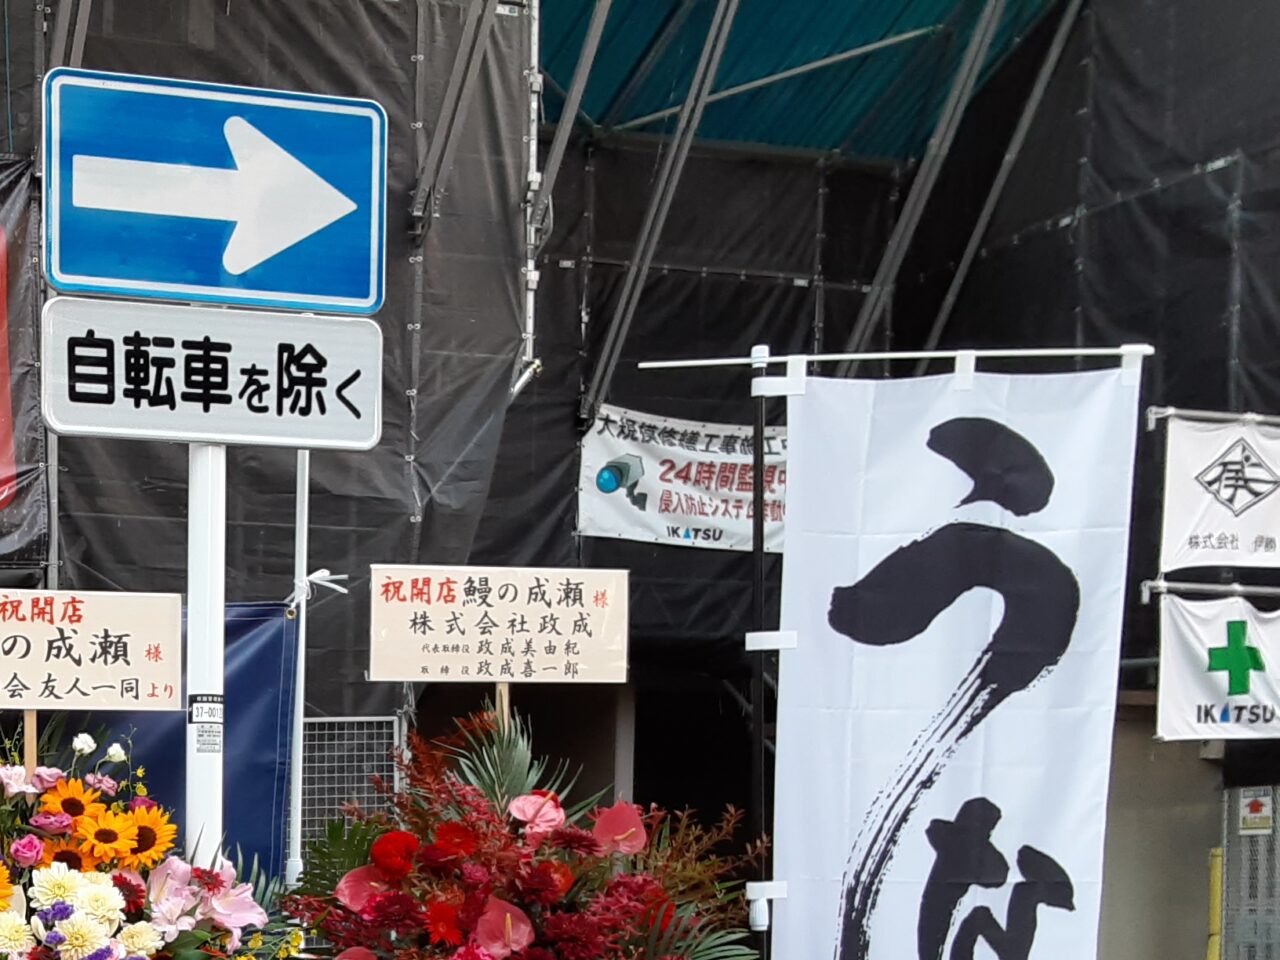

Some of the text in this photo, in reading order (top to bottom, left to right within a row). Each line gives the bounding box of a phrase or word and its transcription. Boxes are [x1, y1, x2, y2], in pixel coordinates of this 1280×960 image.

[67, 329, 362, 420] 自転車を除く
[144, 643, 164, 663] 様
